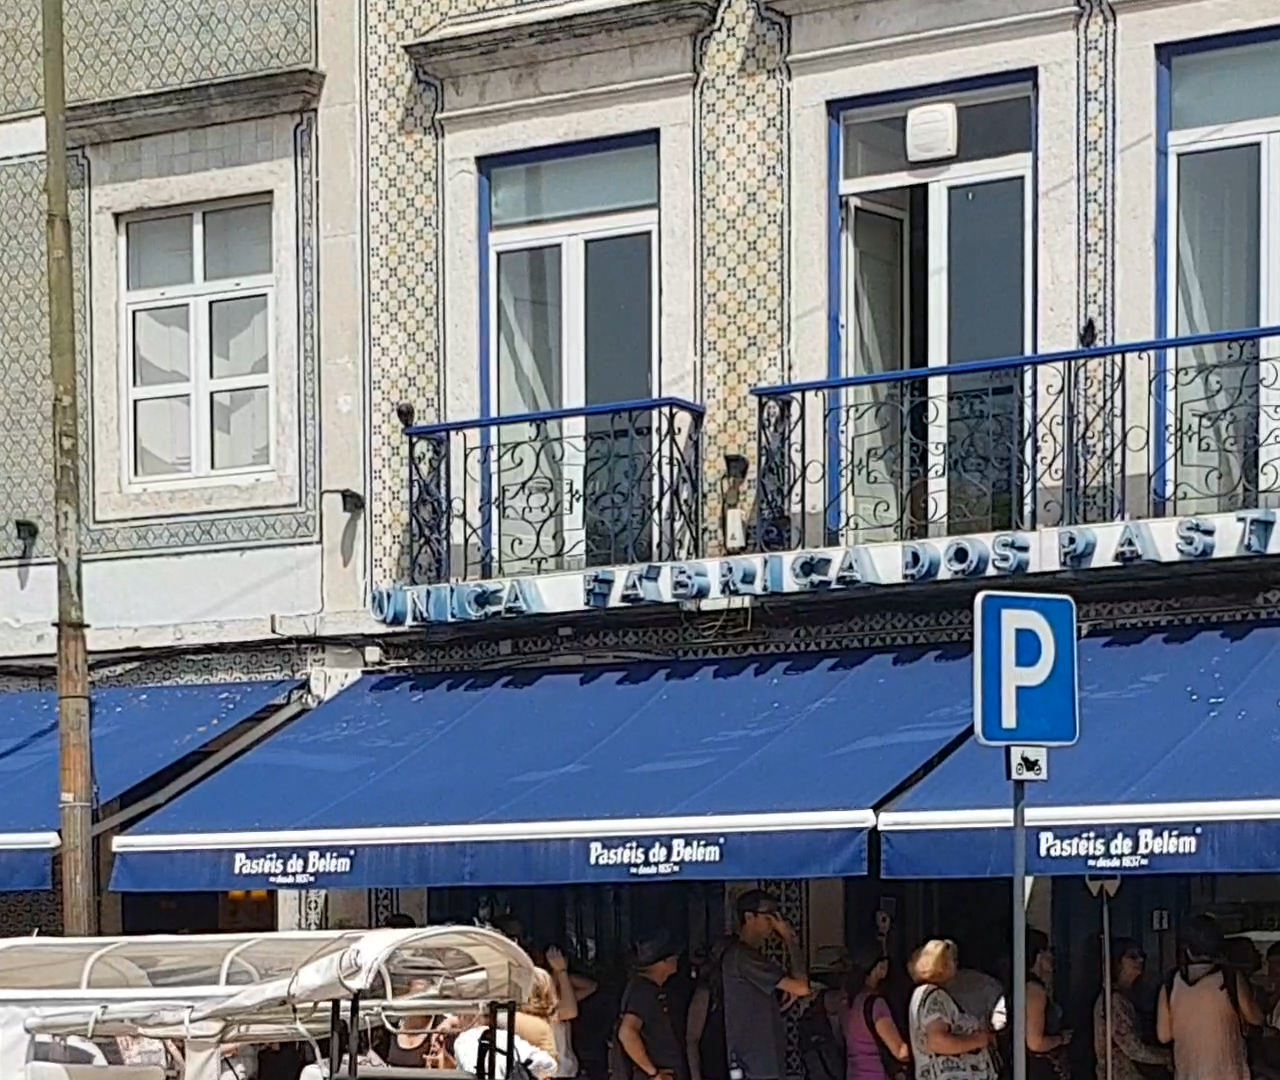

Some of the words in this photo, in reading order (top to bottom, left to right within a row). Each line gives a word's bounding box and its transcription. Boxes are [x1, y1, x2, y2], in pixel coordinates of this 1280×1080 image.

[370, 579, 536, 627] UNICA
[583, 546, 870, 608] FABRICA
[901, 531, 1029, 582] DOS
[1000, 608, 1056, 729] P
[589, 841, 645, 865] Pastéis
[648, 841, 667, 863] de
[670, 838, 720, 862] Belém
[1039, 831, 1105, 857] Pastéis
[1109, 832, 1133, 855] de
[1137, 828, 1197, 855] Belém
[234, 852, 284, 874] Pastéis
[286, 853, 304, 873] de
[307, 850, 351, 872] Belém
